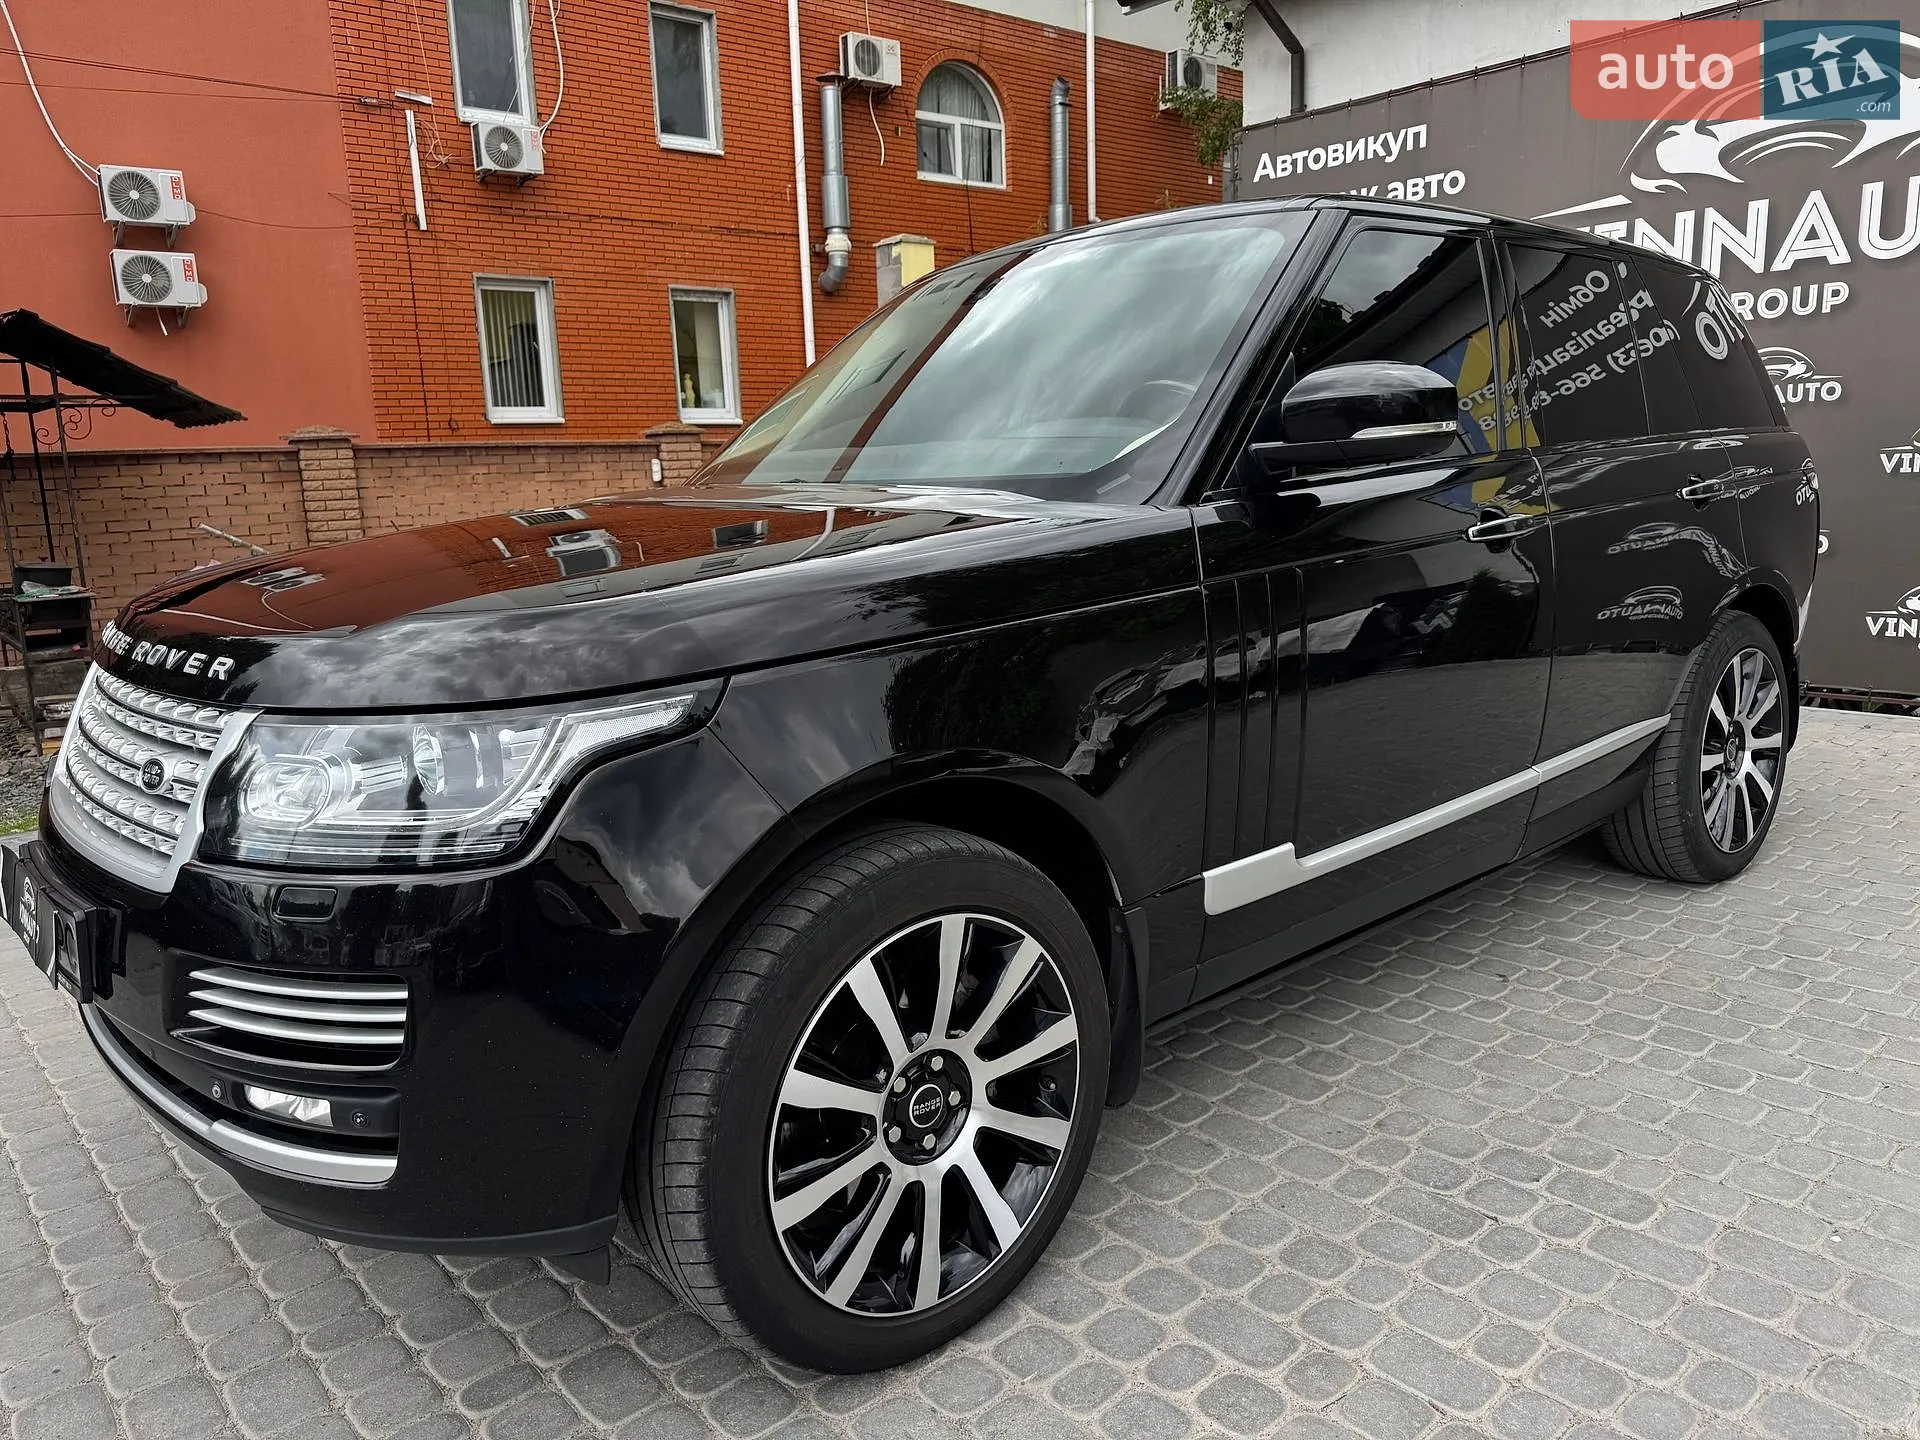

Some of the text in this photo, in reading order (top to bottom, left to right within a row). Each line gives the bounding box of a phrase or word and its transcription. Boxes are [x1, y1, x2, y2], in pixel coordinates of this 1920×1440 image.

[1252, 123, 1428, 184] Автовикуп
[1386, 169, 1467, 201] авто
[131, 640, 236, 681] ROVER
[914, 1096, 941, 1110] RANGE
[914, 1101, 941, 1117] ROVER
